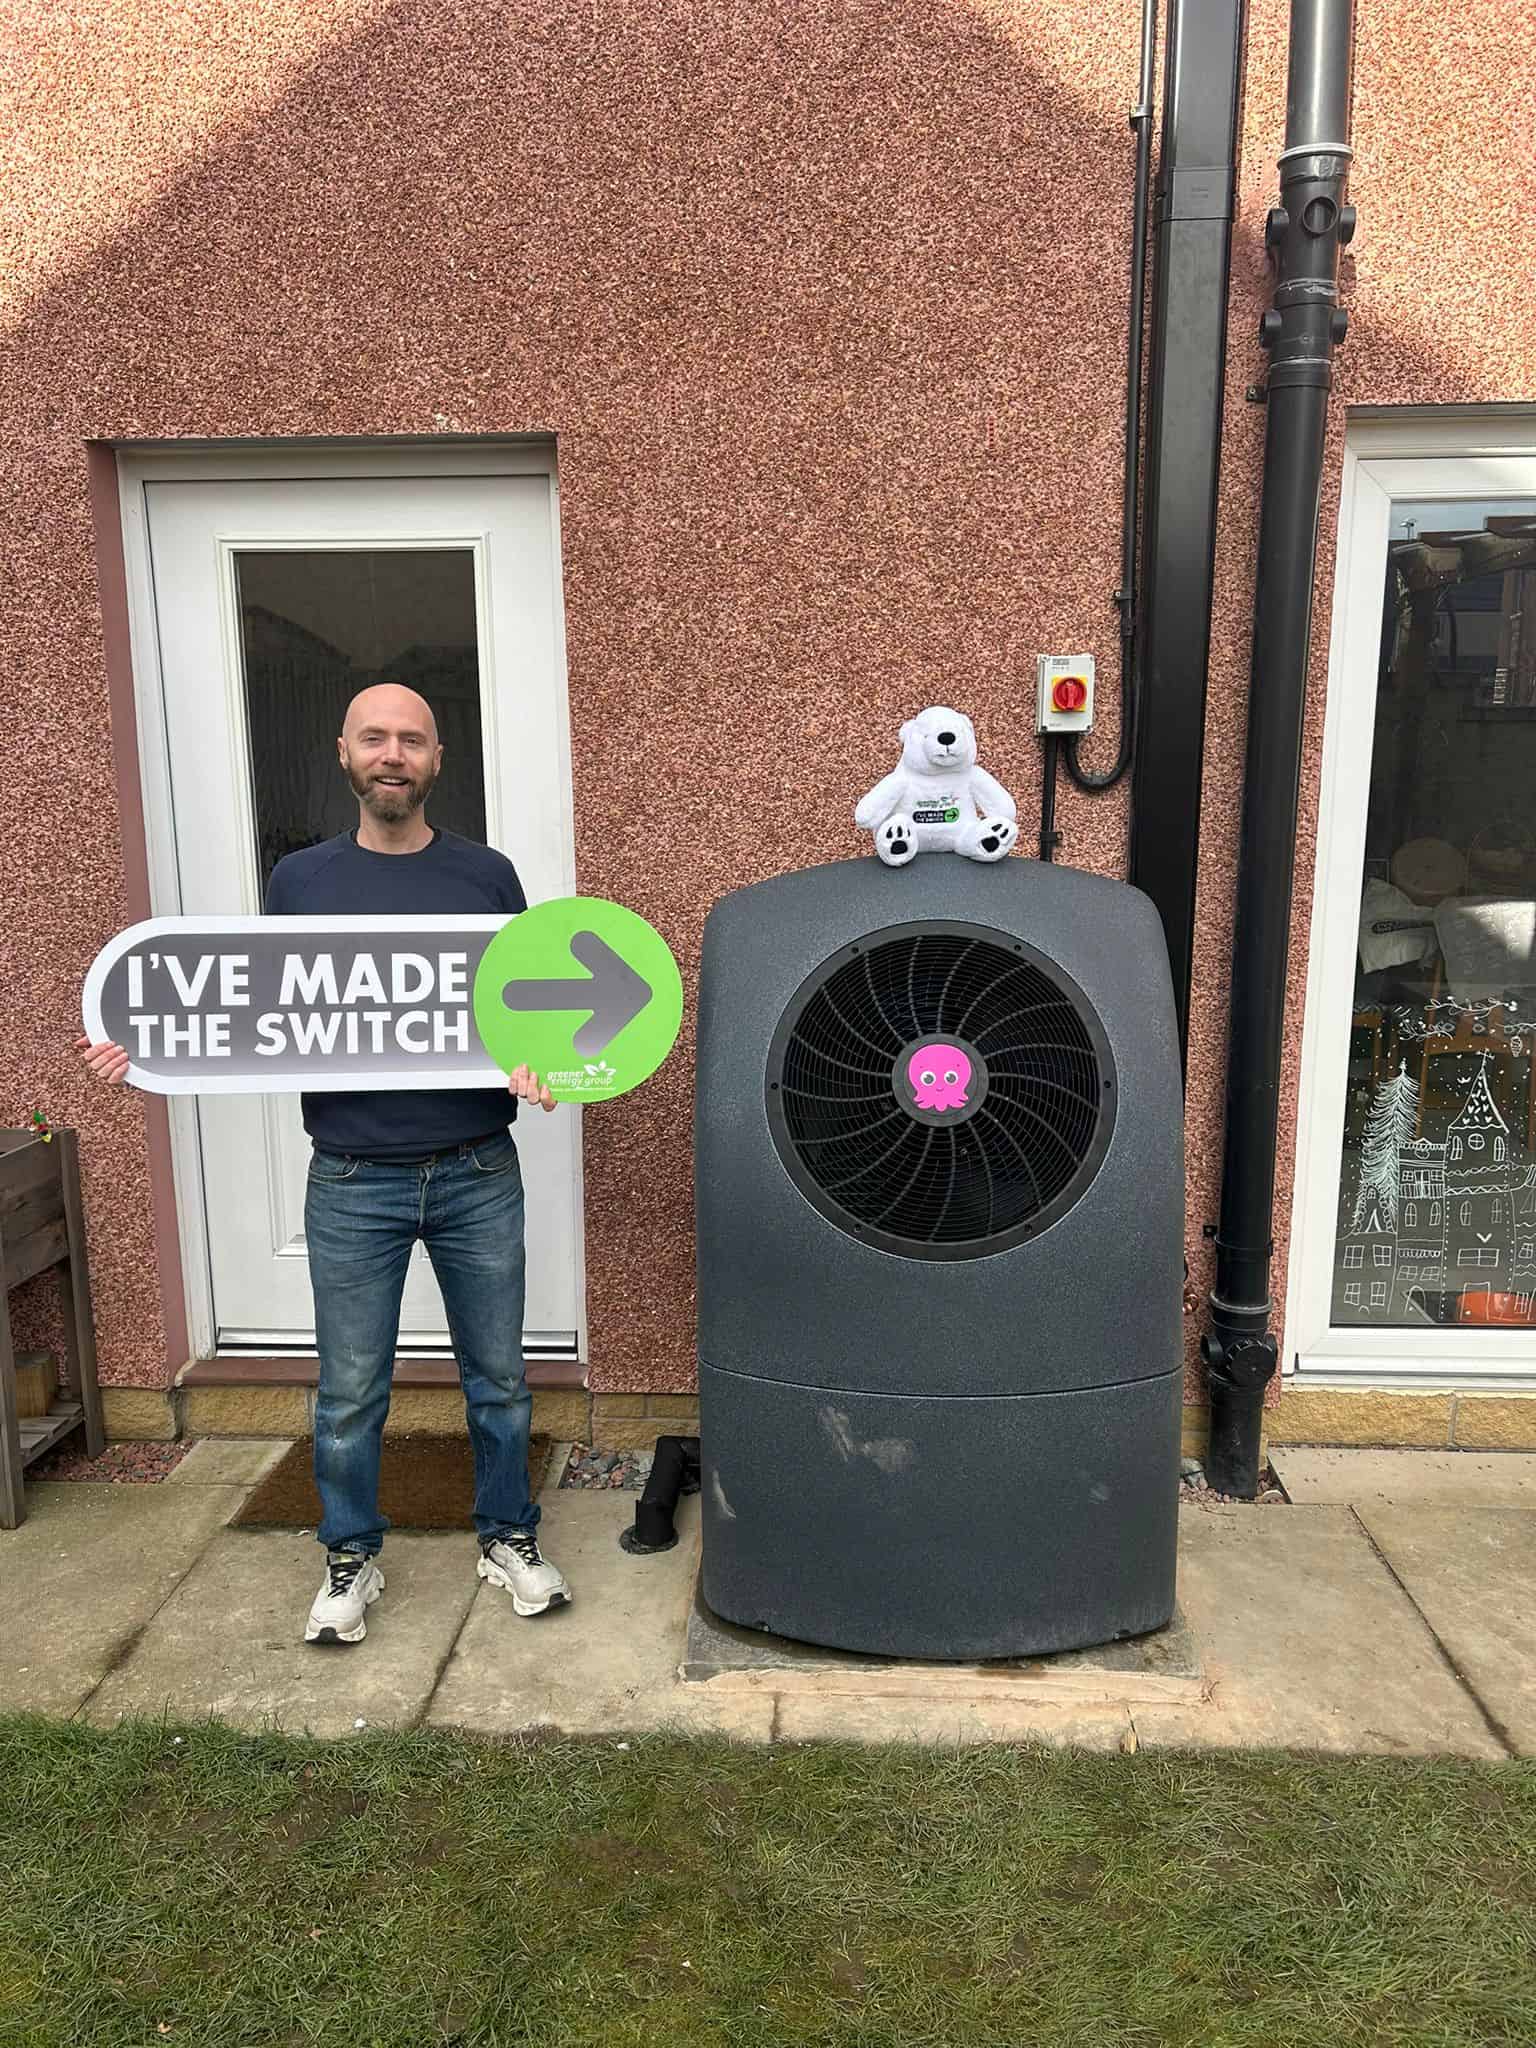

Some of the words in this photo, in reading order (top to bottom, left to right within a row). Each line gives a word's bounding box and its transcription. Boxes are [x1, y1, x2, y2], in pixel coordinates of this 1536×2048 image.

[127, 953, 250, 1007] I'VE
[278, 952, 468, 1005] MADE
[128, 1014, 231, 1058] THE
[254, 1010, 469, 1056] SWITCH
[583, 1077, 613, 1087] group
